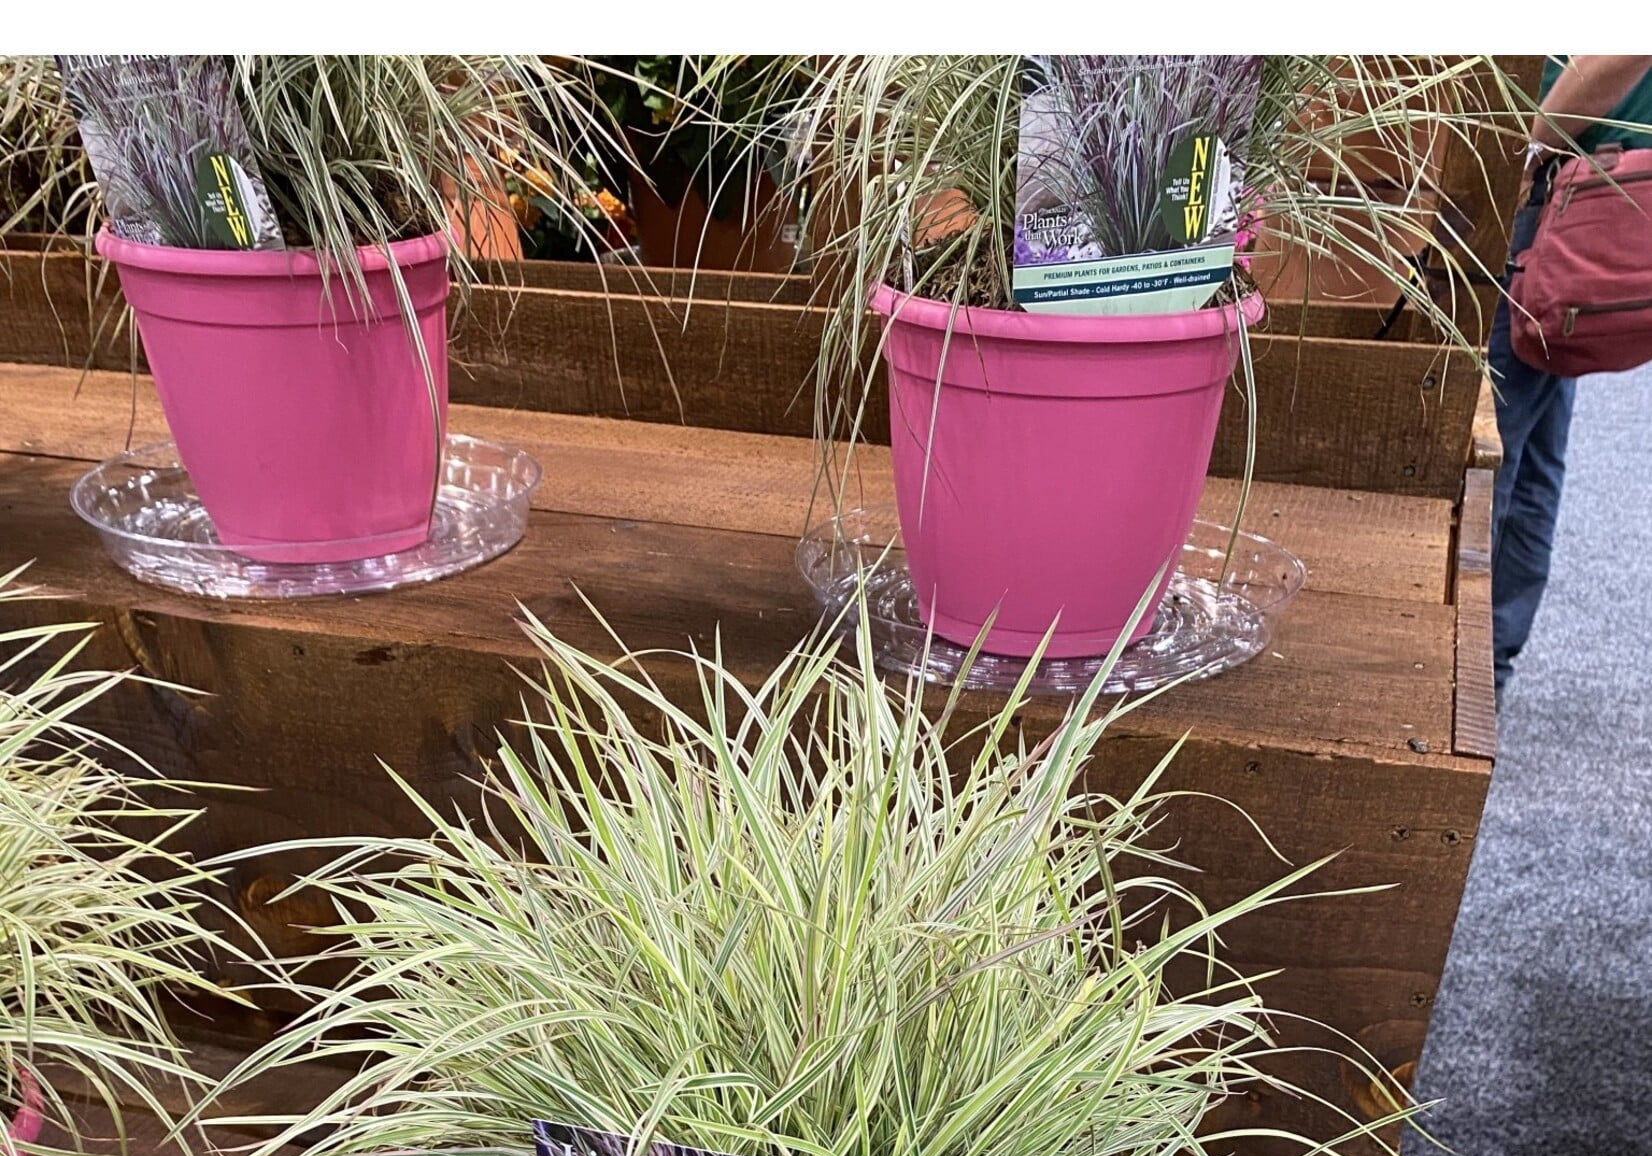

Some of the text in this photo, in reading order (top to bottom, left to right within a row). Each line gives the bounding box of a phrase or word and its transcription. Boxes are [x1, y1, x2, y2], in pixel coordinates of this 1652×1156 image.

[1184, 136, 1210, 240] NEW
[210, 156, 248, 247] NEW
[1022, 213, 1067, 230] Plants
[1043, 227, 1084, 247] Work
[1043, 271, 1073, 281] PREMIUM
[1074, 268, 1097, 278] PLANTS
[1099, 267, 1110, 276] FOR
[1142, 262, 1162, 271] PATIOS
[1170, 256, 1205, 268] CONTAINERS
[1070, 287, 1090, 296] Shade
[1096, 285, 1110, 294] Cold
[1112, 282, 1130, 293] Hardy
[1173, 272, 1211, 284] Well-drained
